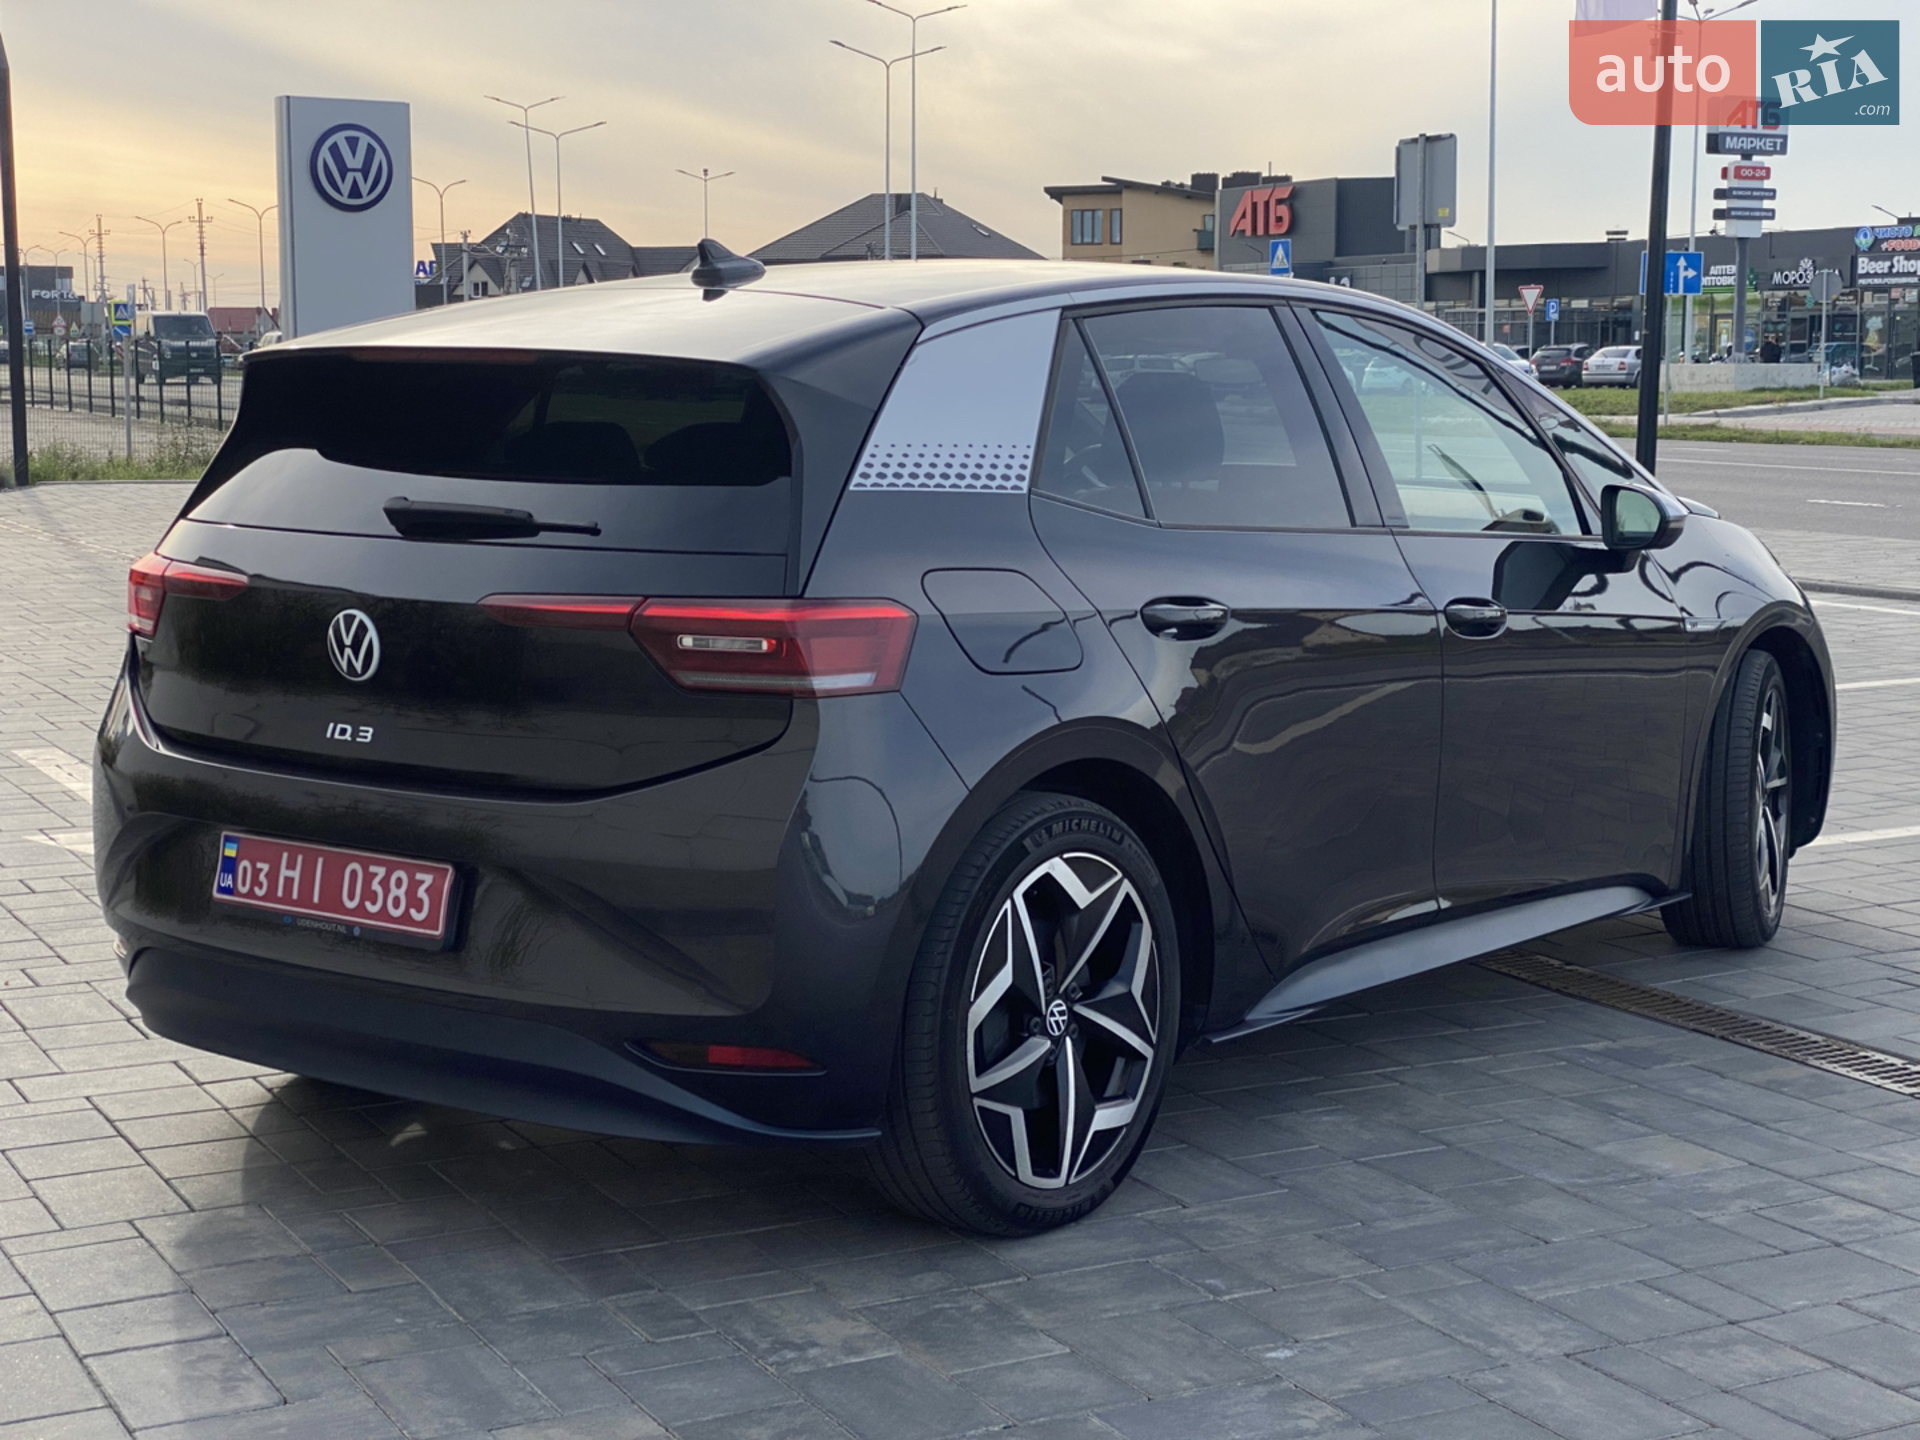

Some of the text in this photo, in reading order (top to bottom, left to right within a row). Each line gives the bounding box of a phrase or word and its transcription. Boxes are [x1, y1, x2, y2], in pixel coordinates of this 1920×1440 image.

[1725, 136, 1783, 151] МАРКЕТ
[1229, 186, 1294, 237] АТБ
[1858, 257, 1891, 274] Beer
[1052, 819, 1122, 842] MICHELIN
[219, 872, 233, 888] UA
[237, 859, 270, 897] 03
[342, 862, 433, 921] 0383
